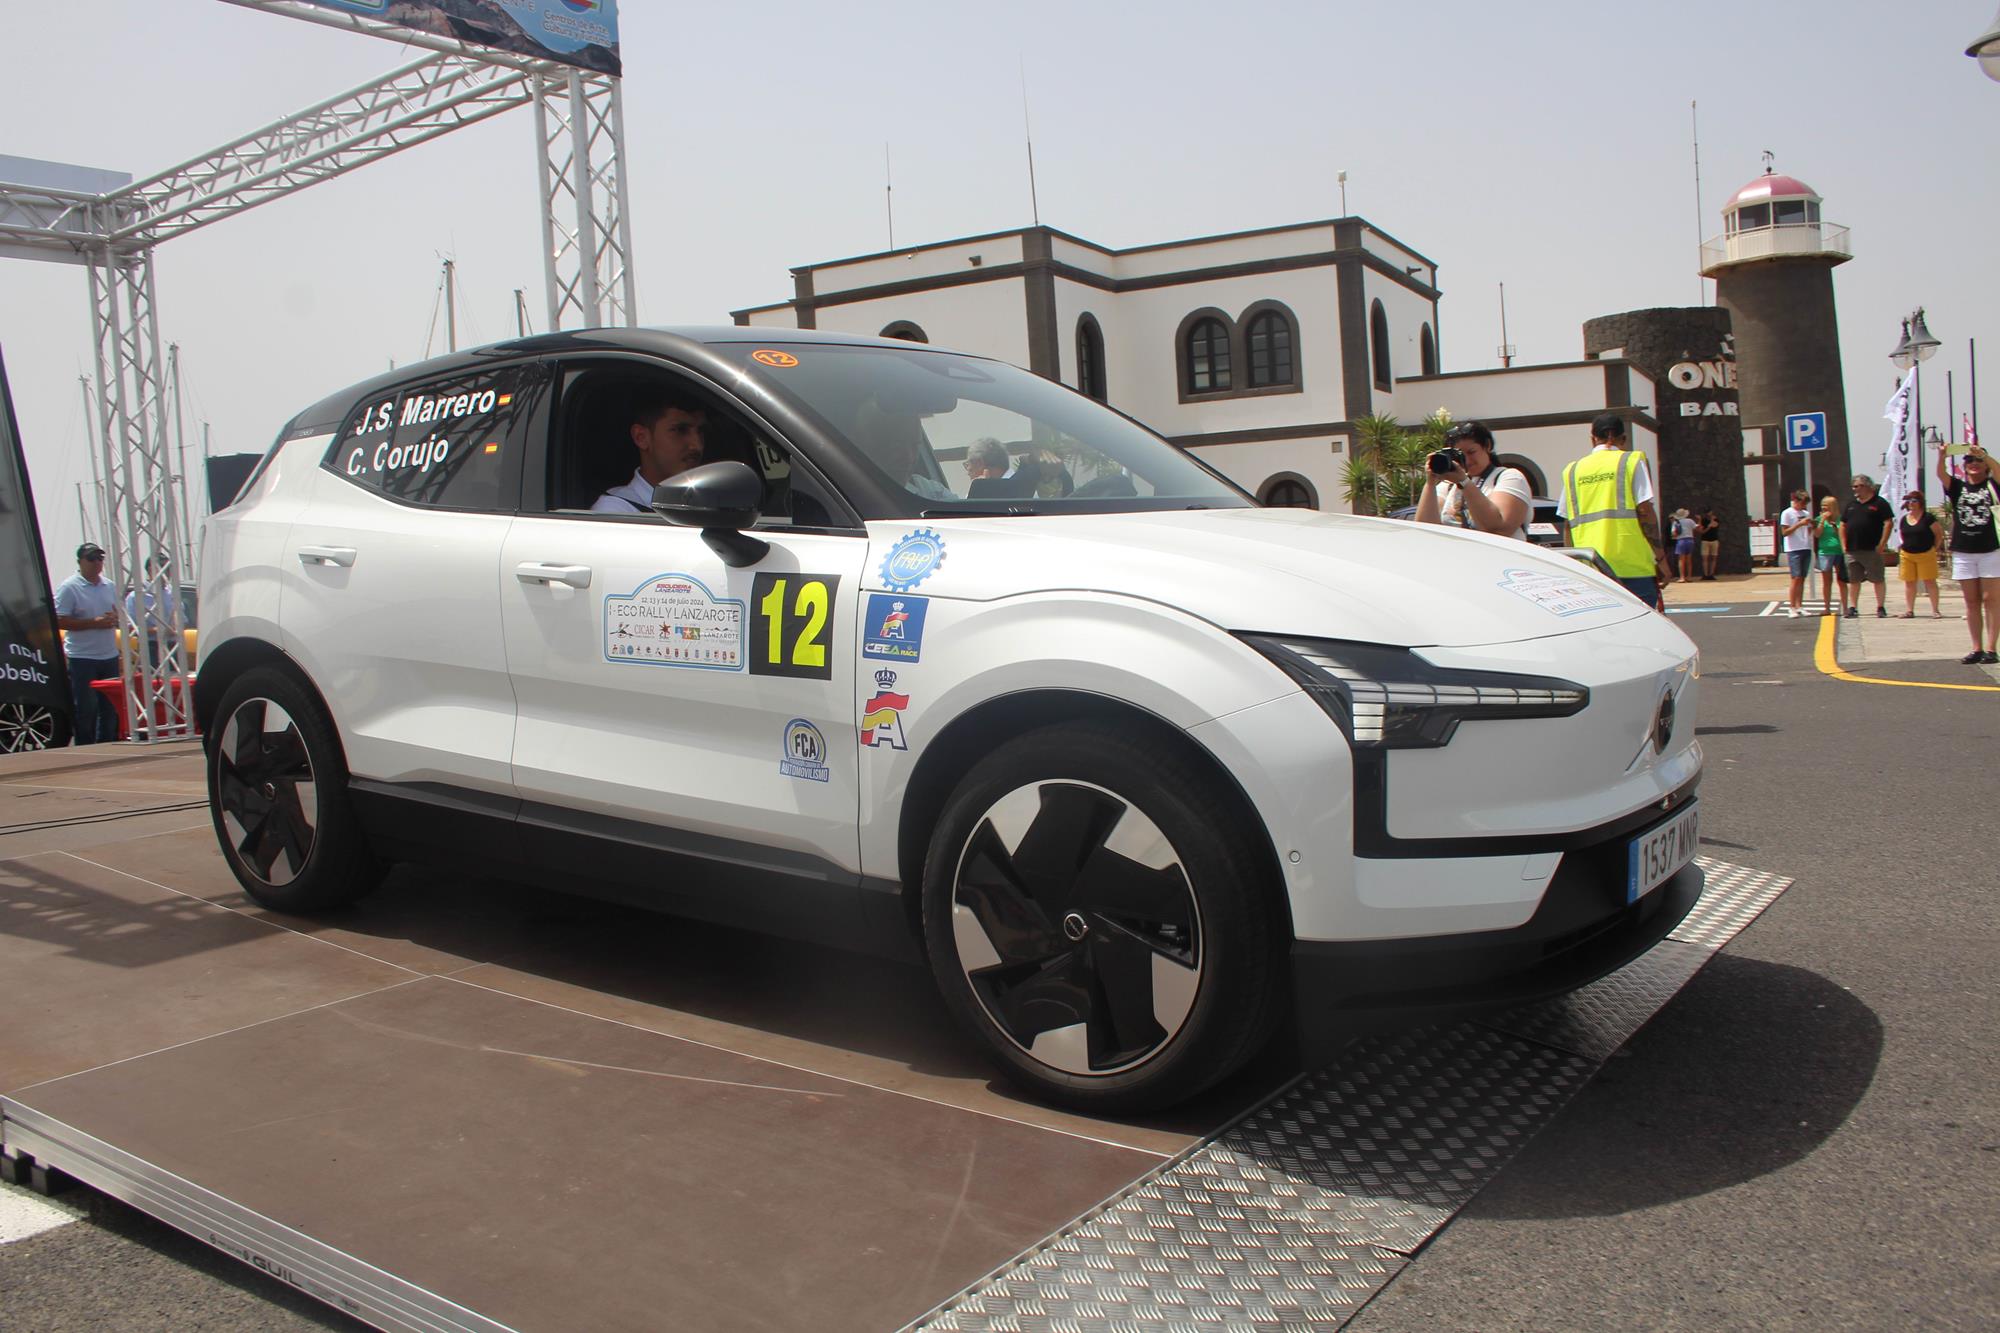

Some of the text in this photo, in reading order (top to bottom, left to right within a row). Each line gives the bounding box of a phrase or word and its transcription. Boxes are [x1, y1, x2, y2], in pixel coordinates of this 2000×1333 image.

[544, 9, 576, 25] Centros
[1668, 361, 1738, 390] ONE
[400, 390, 496, 427] Marrero
[1680, 402, 1738, 416] BAR
[1794, 419, 1816, 447] P
[347, 434, 449, 475] C. Corujo
[618, 604, 637, 617] ECO
[639, 605, 672, 619] RALLY
[674, 607, 739, 623] LANZAROTE
[762, 580, 828, 667] 12
[795, 733, 816, 758] FCA
[781, 763, 828, 781] AUTOMOVILISMO
[1644, 827, 1675, 885] 1537
[253, 1256, 302, 1288] GUIL
